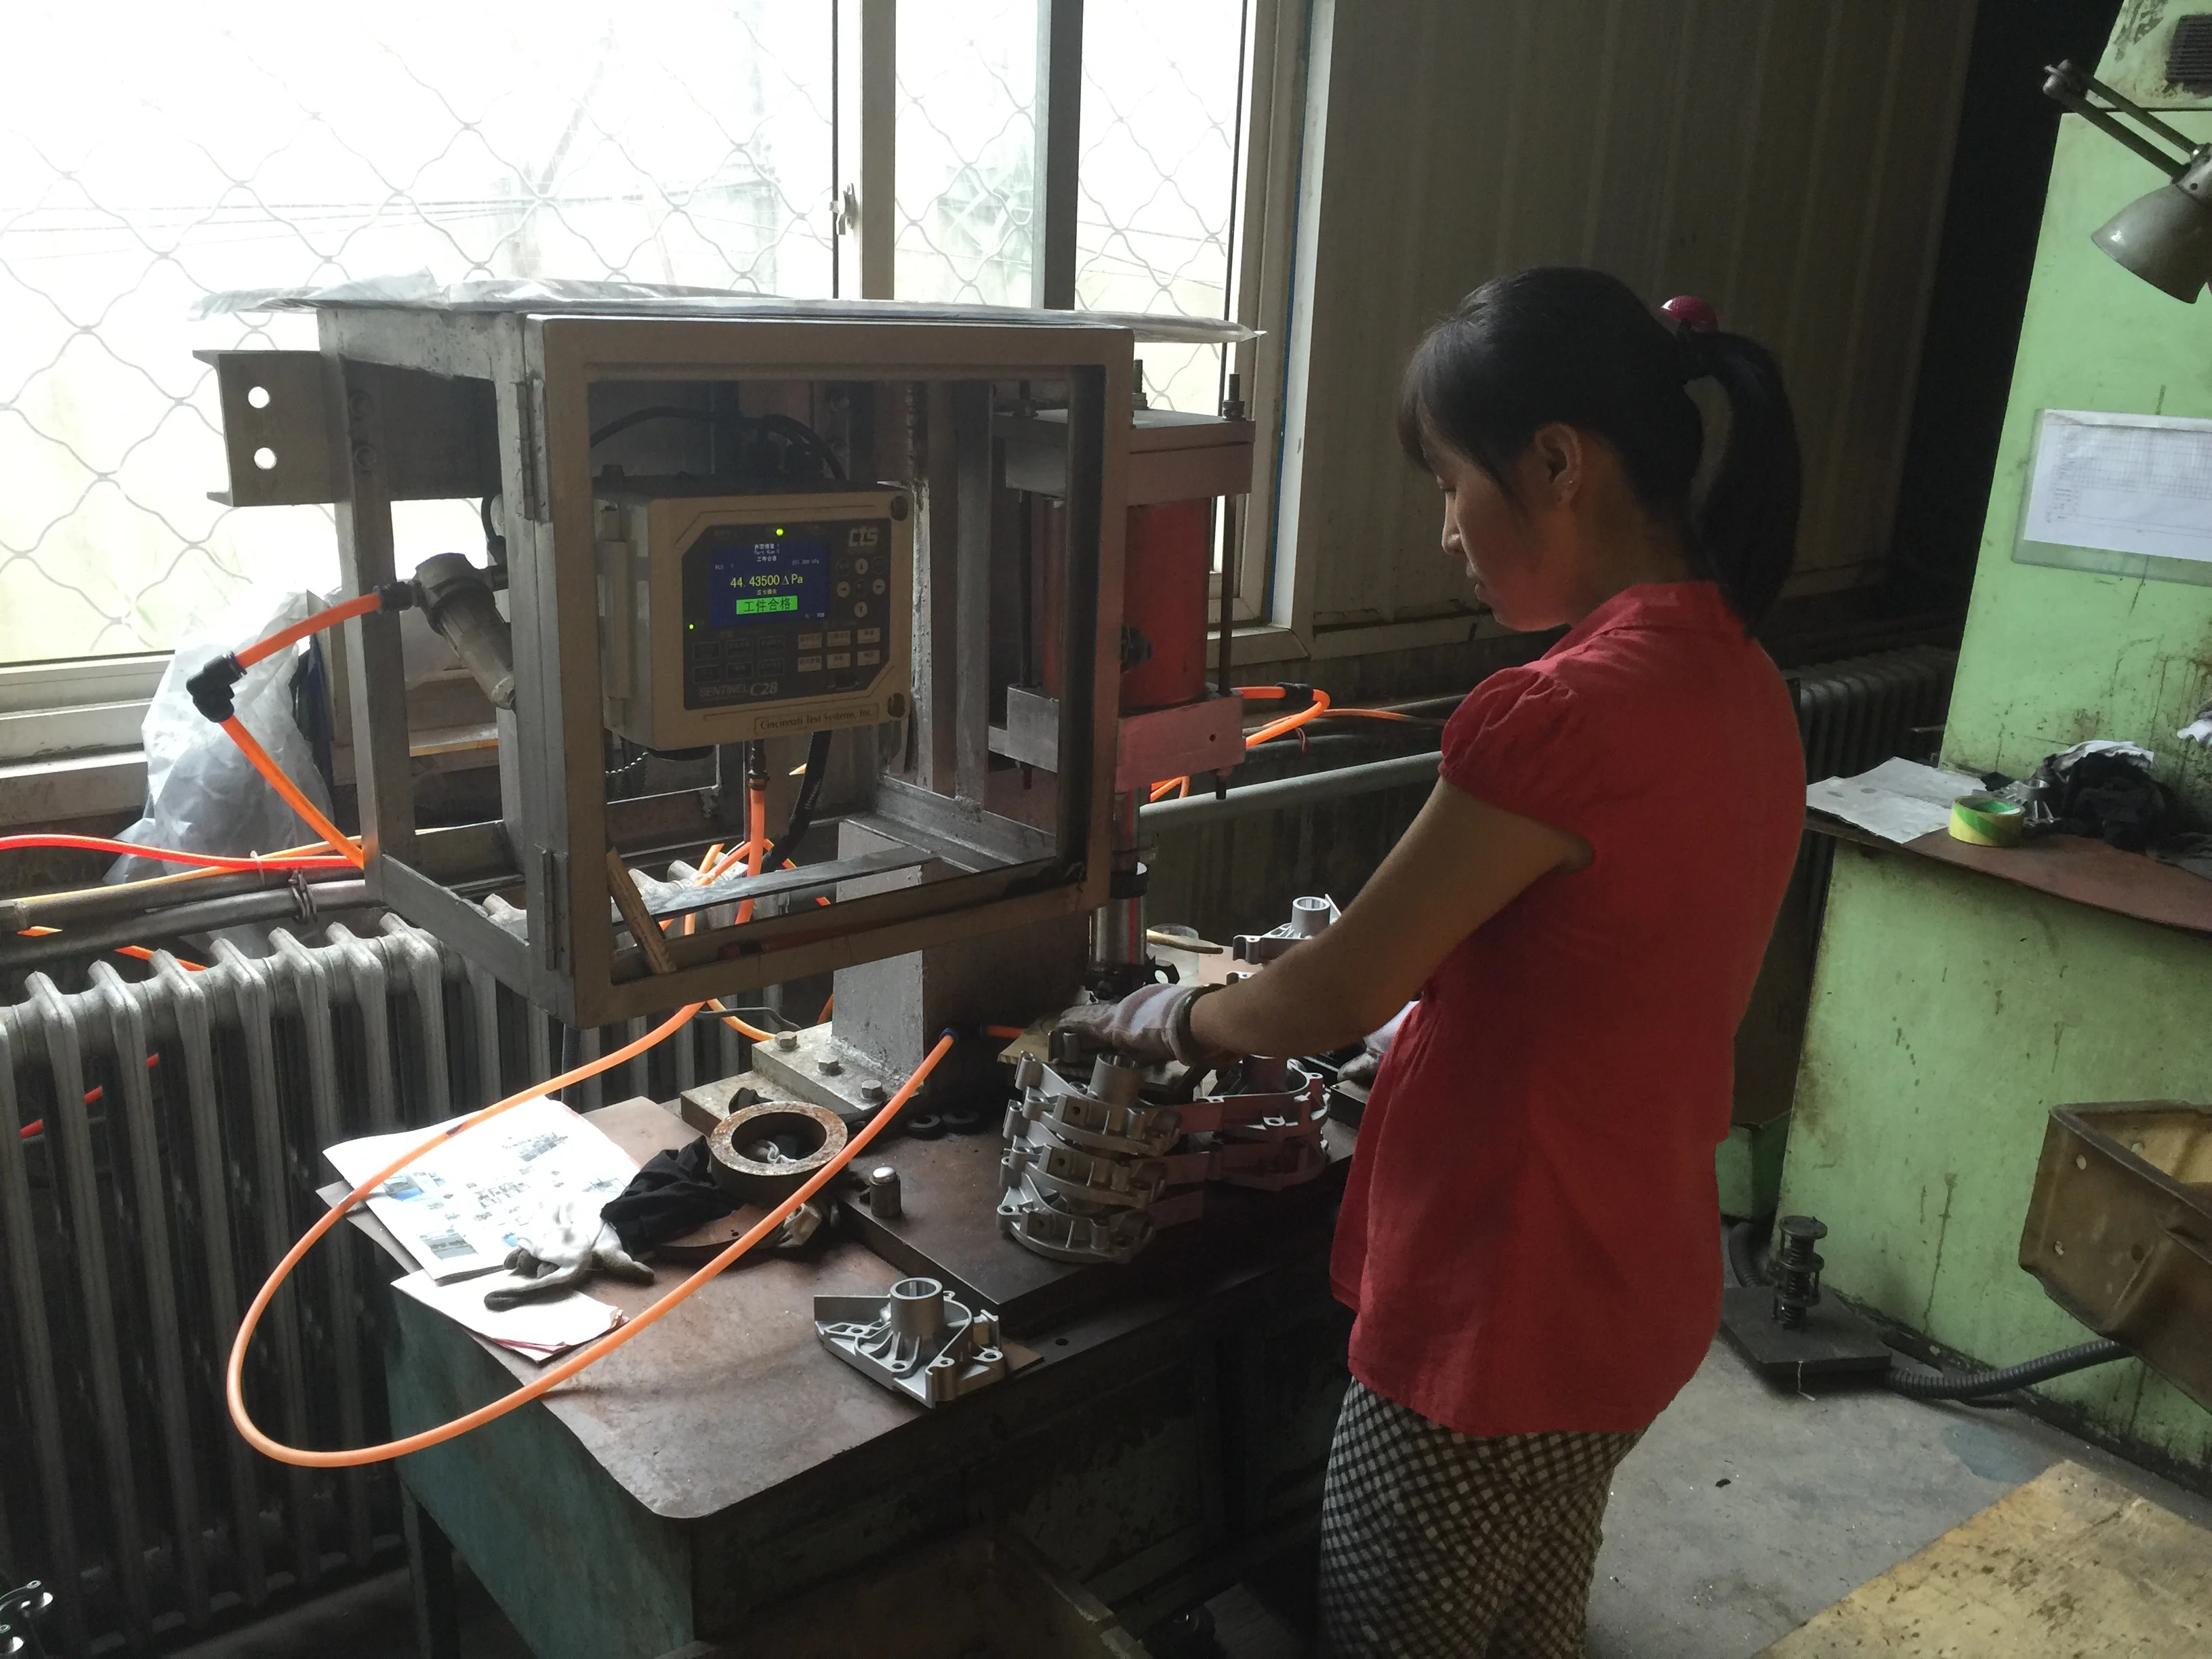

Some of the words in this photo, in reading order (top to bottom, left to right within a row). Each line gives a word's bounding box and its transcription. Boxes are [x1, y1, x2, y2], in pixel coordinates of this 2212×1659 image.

[743, 597, 791, 613] 工件合格
[699, 684, 748, 697] SENTINEL
[750, 681, 779, 697] C28
[760, 716, 803, 730] Cincinnati
[806, 714, 821, 724] Test
[823, 710, 857, 722] Systems,
[859, 709, 874, 718] Inc.
